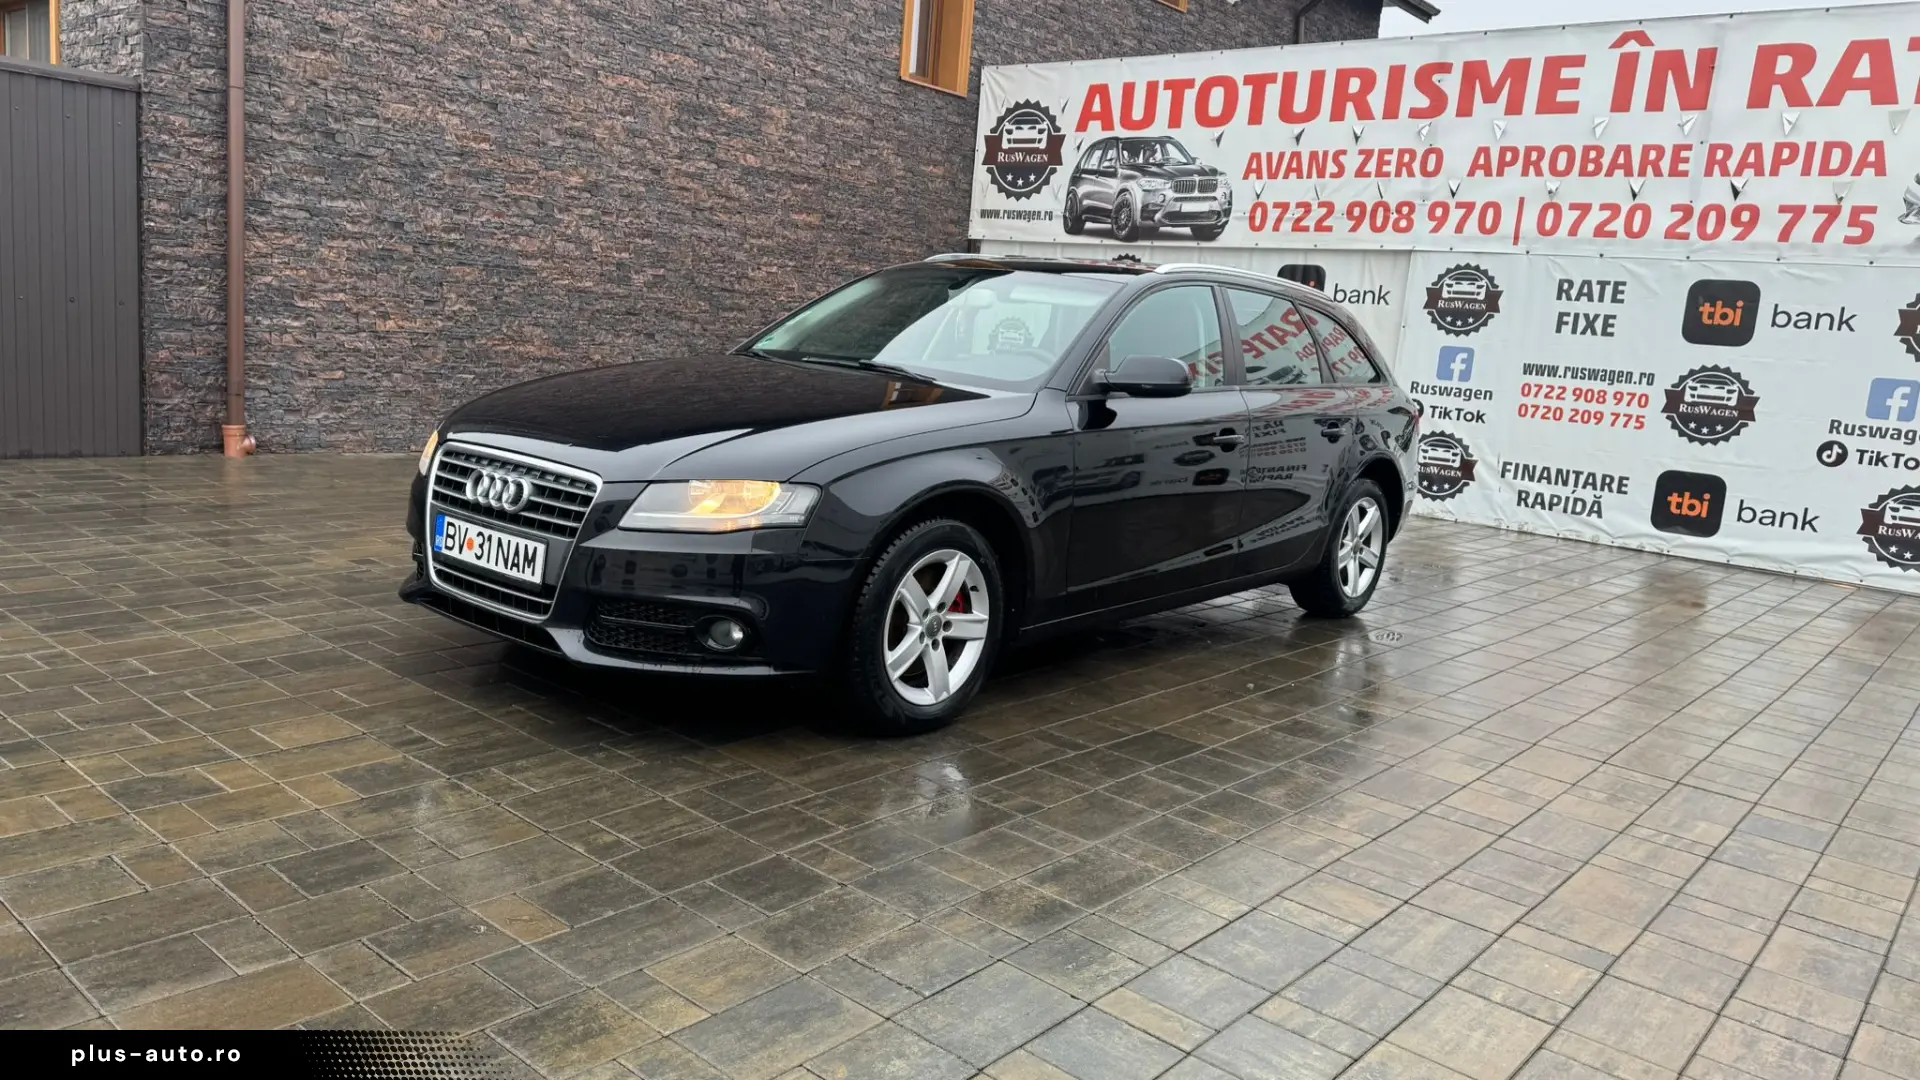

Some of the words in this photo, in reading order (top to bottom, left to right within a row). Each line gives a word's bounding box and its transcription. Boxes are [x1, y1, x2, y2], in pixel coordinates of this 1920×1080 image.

[1075, 54, 1587, 133] AUTOTURISME
[1608, 30, 1719, 113] ÎN
[1746, 36, 1920, 110] RA
[1242, 148, 1348, 180] AVANS
[1354, 146, 1444, 179] ZERO
[1467, 143, 1693, 178] APROBARE
[1703, 140, 1887, 178] RAPIDA
[980, 208, 1054, 222] www.ruswagen.ro
[1248, 201, 1334, 233] 0722
[1346, 201, 1416, 234] 908
[1427, 201, 1502, 235] 970
[1536, 203, 1652, 239] 0720
[1664, 203, 1760, 241] 209
[1776, 204, 1878, 245] 775
[1333, 283, 1391, 306] bank
[1556, 278, 1627, 304] RATE
[1555, 311, 1617, 337] FIXE
[1699, 300, 1744, 327] tbi
[1770, 303, 1857, 332] bank
[1522, 362, 1655, 386] www.ruswagen.ro
[1410, 381, 1493, 401] Ruswagen
[1521, 382, 1565, 401] 0722
[1571, 386, 1608, 405] 908
[1612, 390, 1649, 409] 970
[1429, 405, 1486, 424] TikTok
[1518, 403, 1563, 422] 0720
[1568, 407, 1604, 426] 209
[1609, 412, 1646, 430] 775
[1828, 419, 1920, 446] Ruswag
[1500, 461, 1630, 495] FINANȚARE
[1516, 489, 1603, 519] RAPIDĂ
[1667, 491, 1712, 518] tbi
[1736, 499, 1820, 533] bank
[444, 521, 468, 555] BV
